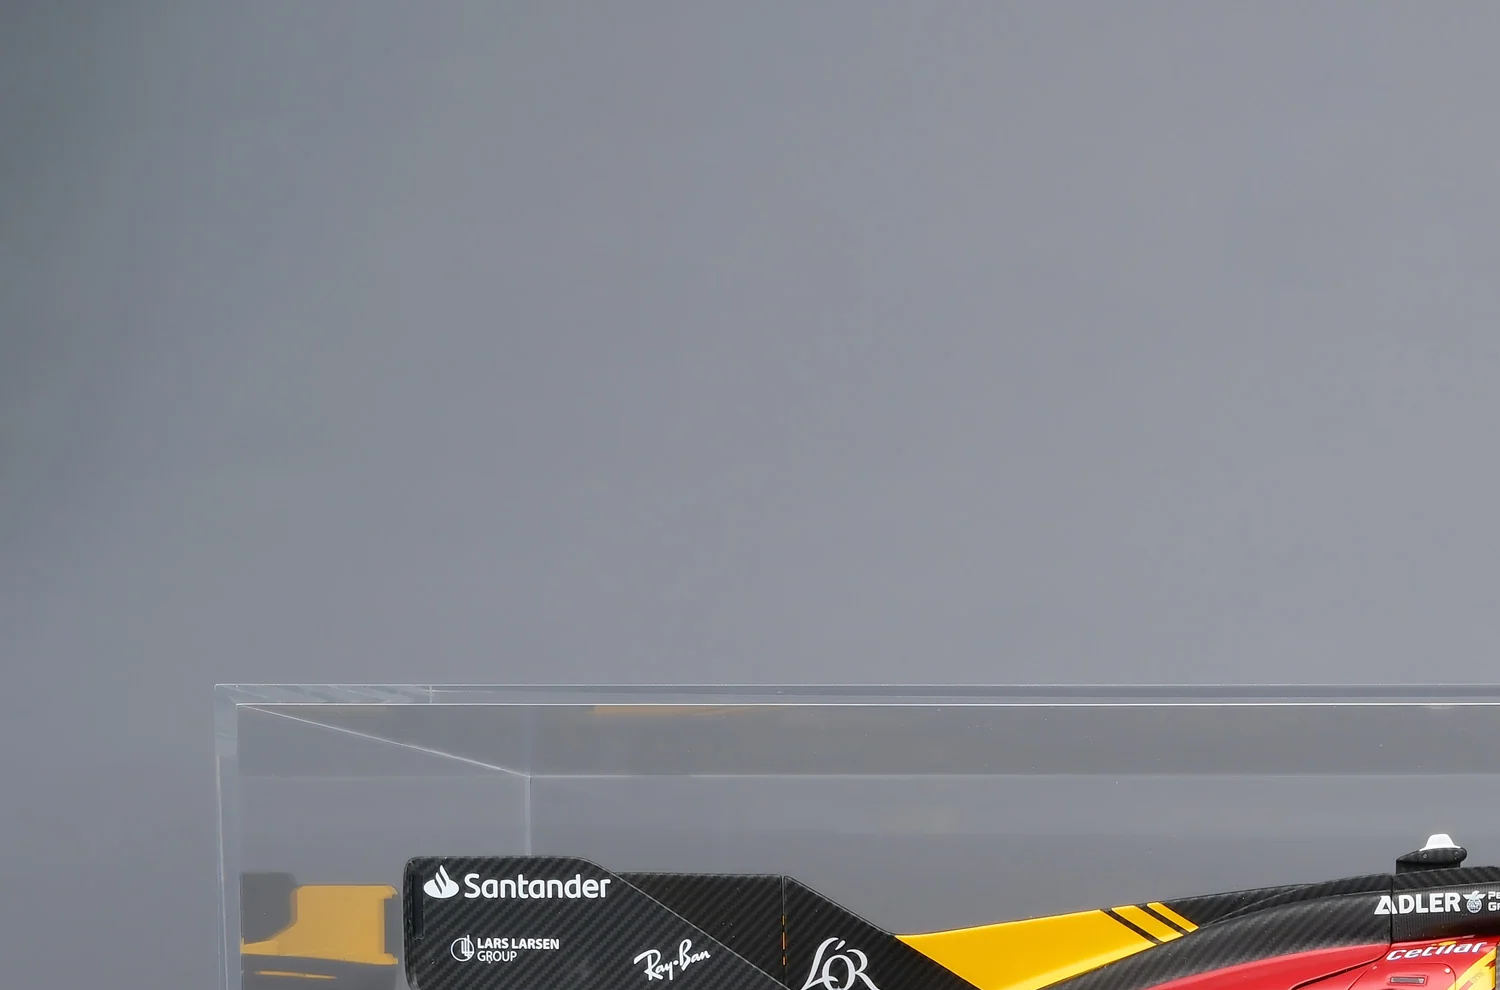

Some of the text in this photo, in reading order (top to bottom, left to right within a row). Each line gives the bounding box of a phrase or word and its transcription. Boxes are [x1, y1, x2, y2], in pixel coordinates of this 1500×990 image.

[464, 873, 611, 899] Santander
[1374, 893, 1460, 915] ADLER
[477, 938, 560, 949] LARS LARSEN
[477, 951, 517, 962] GROUP
